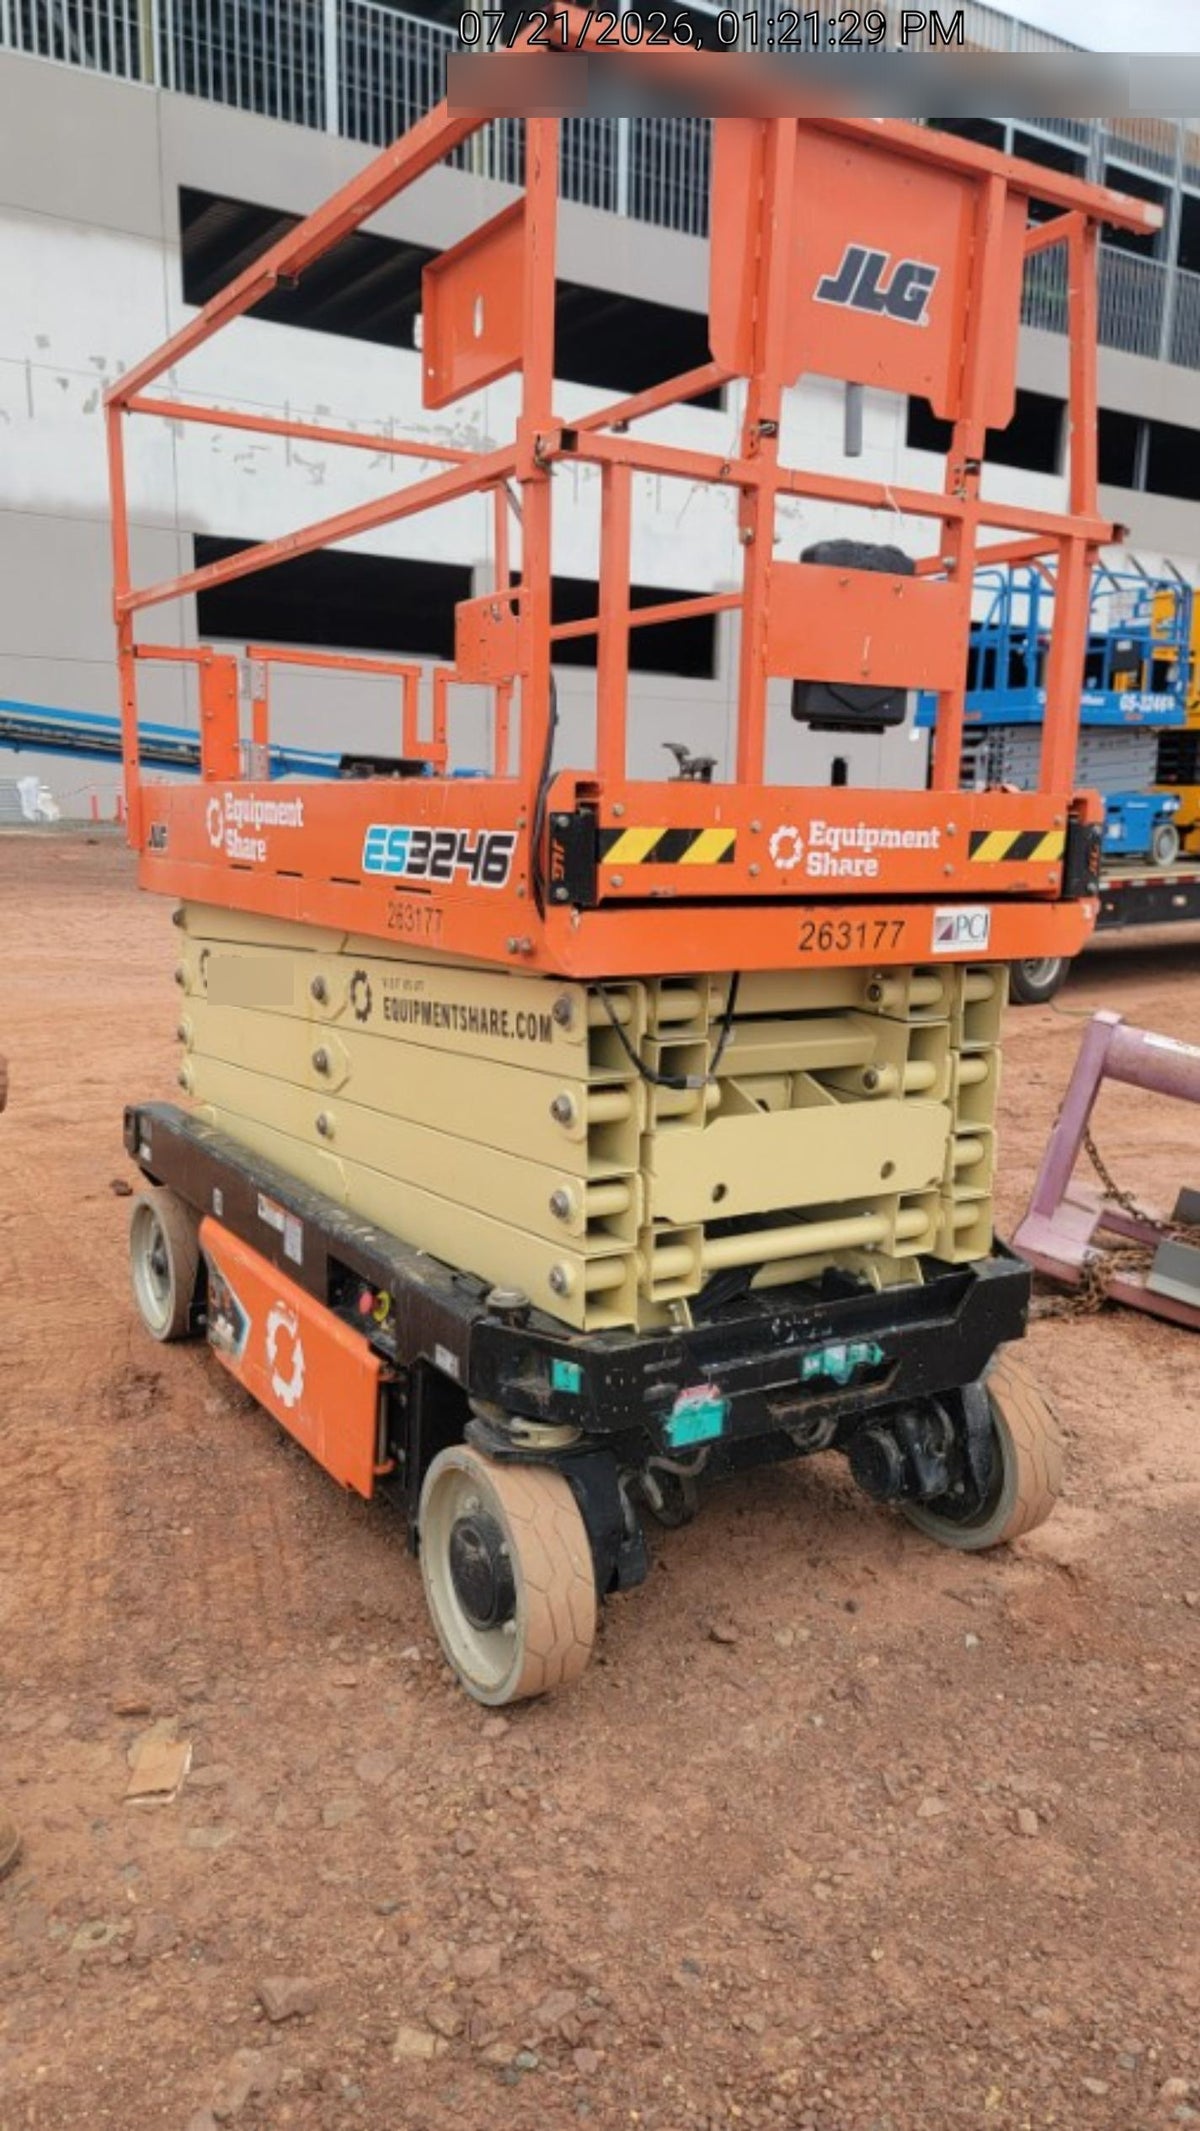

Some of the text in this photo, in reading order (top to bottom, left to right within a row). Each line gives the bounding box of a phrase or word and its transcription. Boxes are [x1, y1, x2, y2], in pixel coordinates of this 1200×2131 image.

[814, 243, 938, 326] JLG
[224, 792, 304, 831] Equipment
[224, 828, 267, 862] Share
[808, 820, 940, 852] Equipment
[362, 824, 518, 889] ES3246
[806, 851, 879, 878] Share
[387, 901, 443, 935] 263177
[798, 919, 906, 951] 263177
[955, 912, 989, 940] PCI
[383, 997, 553, 1044] EQUIPMENTSHARE.COM
